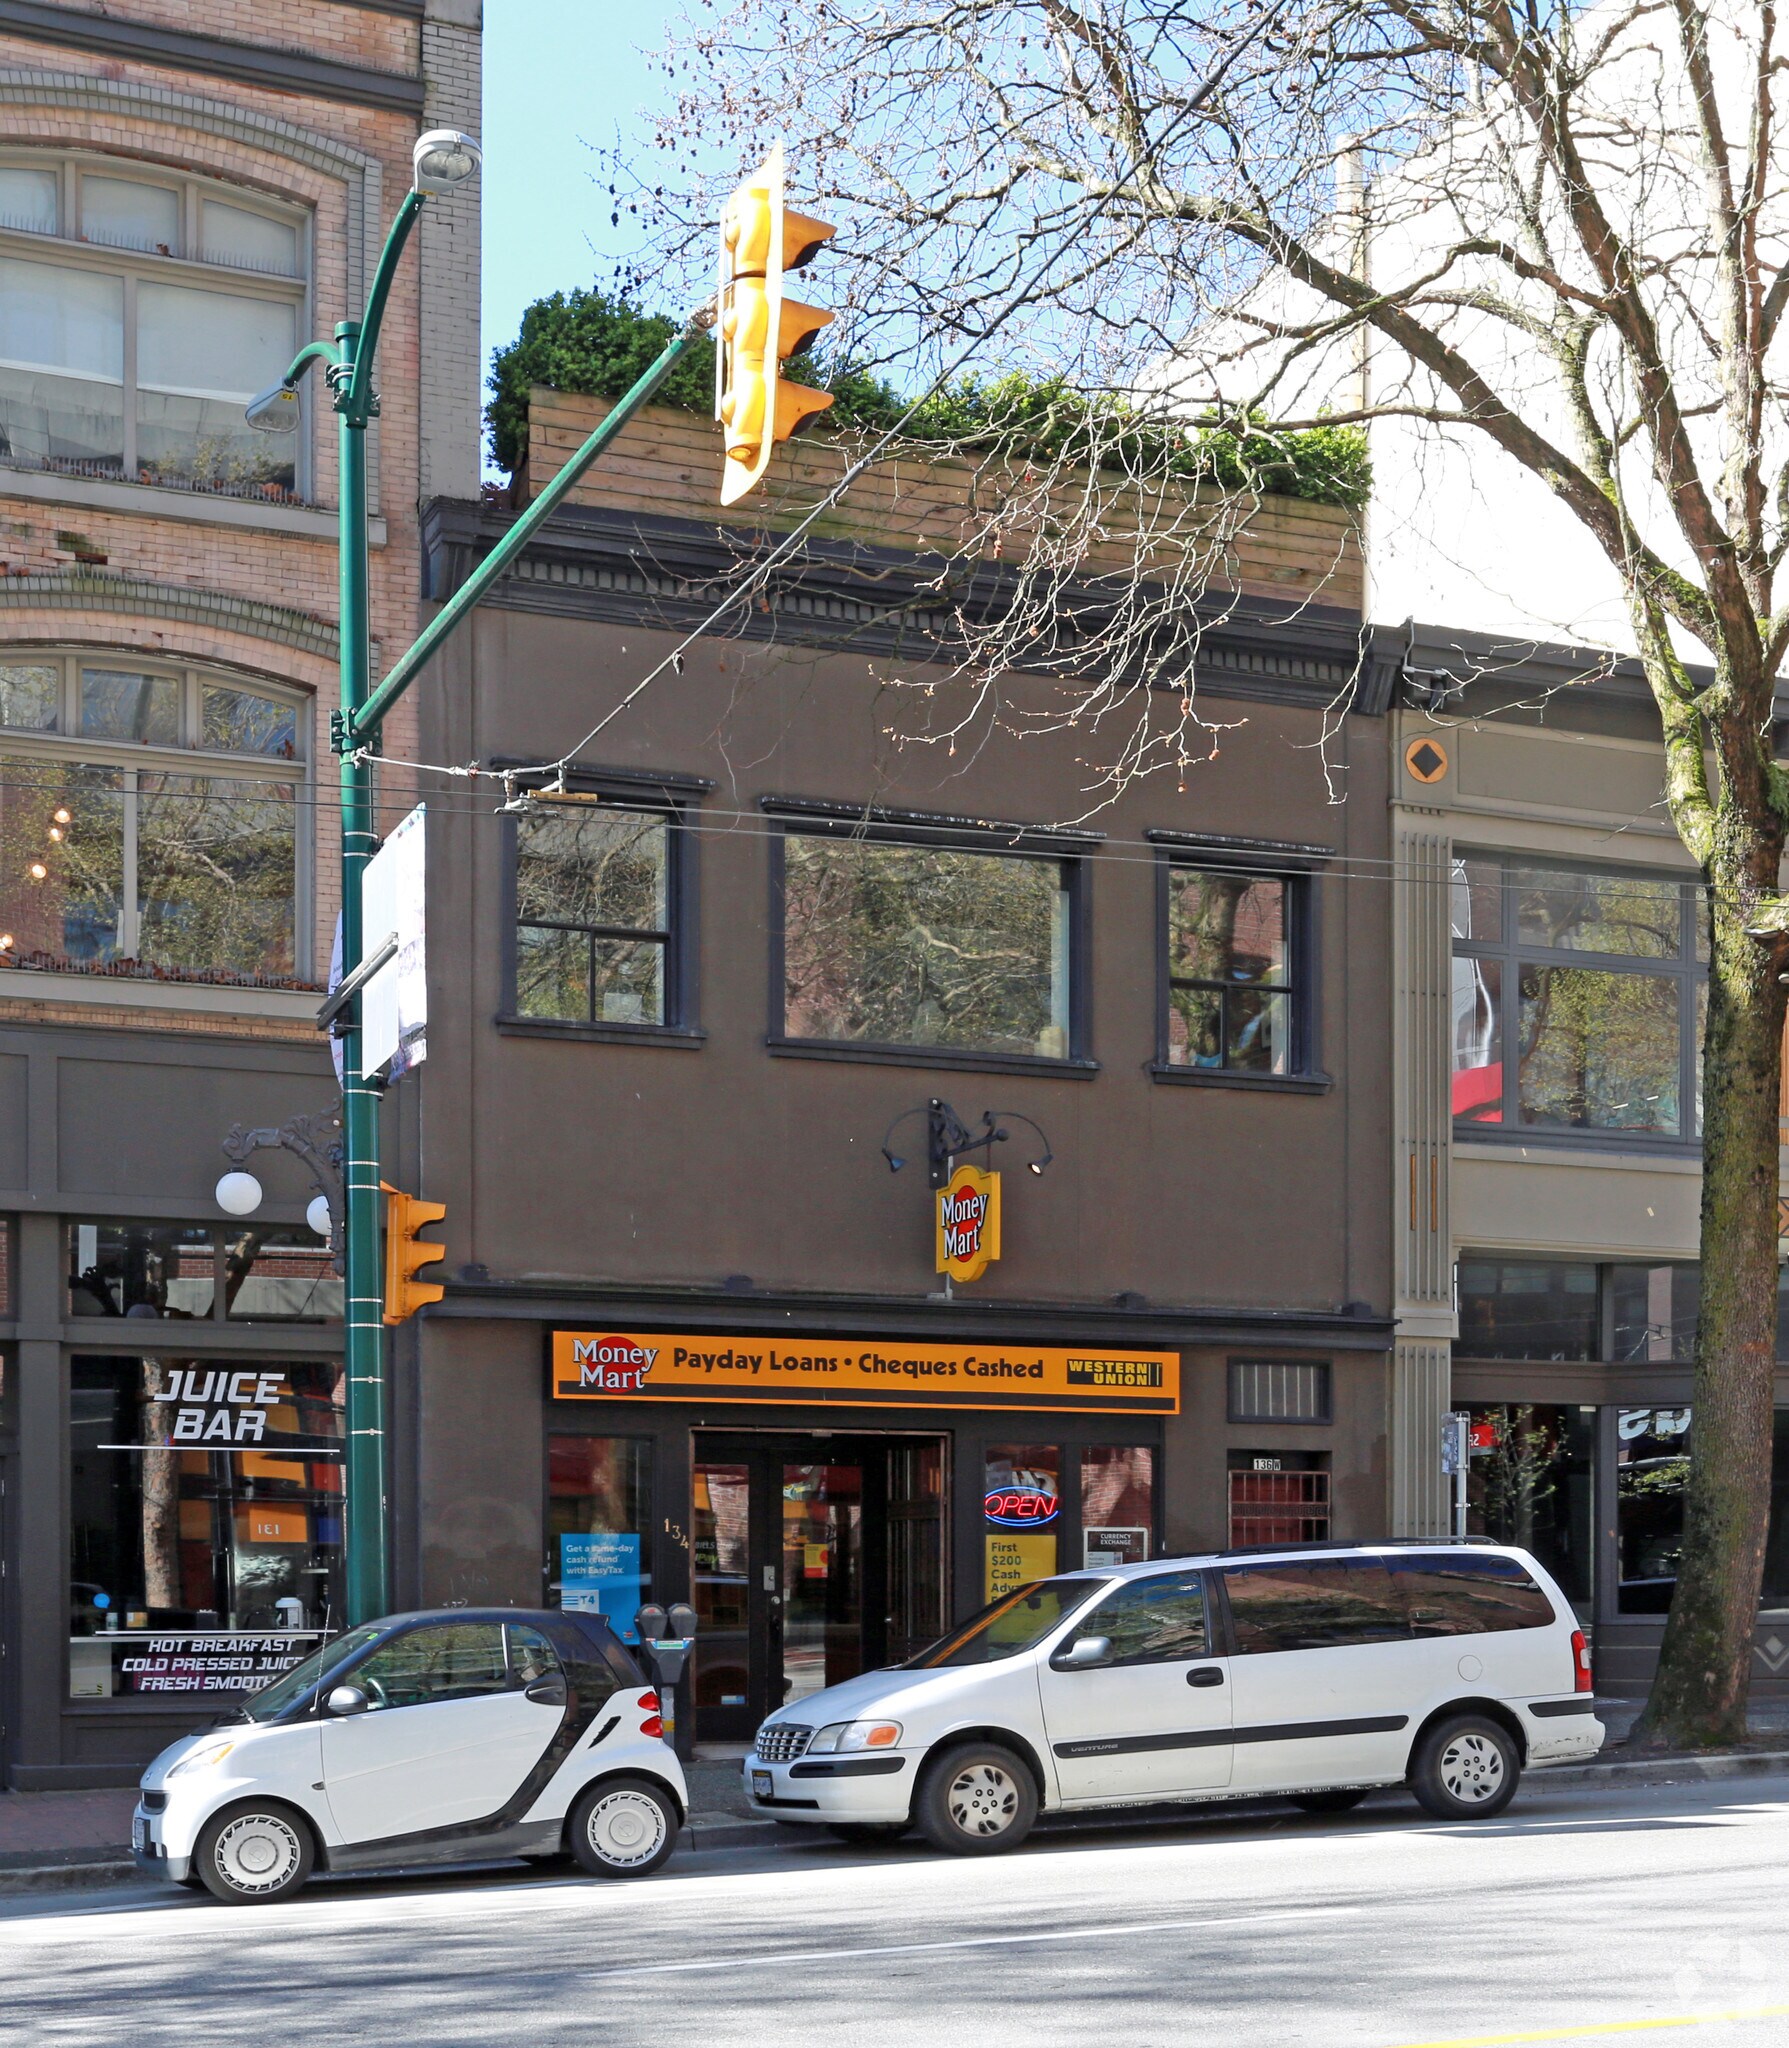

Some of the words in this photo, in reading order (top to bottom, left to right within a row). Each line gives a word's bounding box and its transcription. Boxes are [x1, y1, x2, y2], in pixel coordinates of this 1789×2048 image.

[941, 1193, 988, 1227] Money
[943, 1226, 980, 1259] Mart
[572, 1338, 660, 1372] Money
[673, 1347, 763, 1374] Payday
[770, 1350, 838, 1371] Loans
[858, 1353, 957, 1379] Cheques
[963, 1356, 1043, 1378] Cashed
[1069, 1360, 1147, 1374] WESTERN
[578, 1364, 646, 1389] Mart
[1093, 1372, 1147, 1386] UNION
[153, 1370, 285, 1404] JUICE
[173, 1408, 267, 1441] BAR
[985, 1495, 1057, 1516] OPEN
[566, 1544, 582, 1553] Get
[991, 1542, 1017, 1552] First
[566, 1555, 587, 1564] cash
[991, 1555, 1022, 1566] $200
[566, 1566, 586, 1575] with
[991, 1569, 1021, 1579] Cash
[580, 1595, 596, 1605] T4
[148, 1639, 187, 1653] HOT
[191, 1638, 297, 1653] BREAKFAST
[121, 1658, 168, 1672] COLD
[171, 1657, 253, 1671] PRESSED
[140, 1676, 200, 1691] FRESH
[1071, 1744, 1119, 1752] VENTURE
